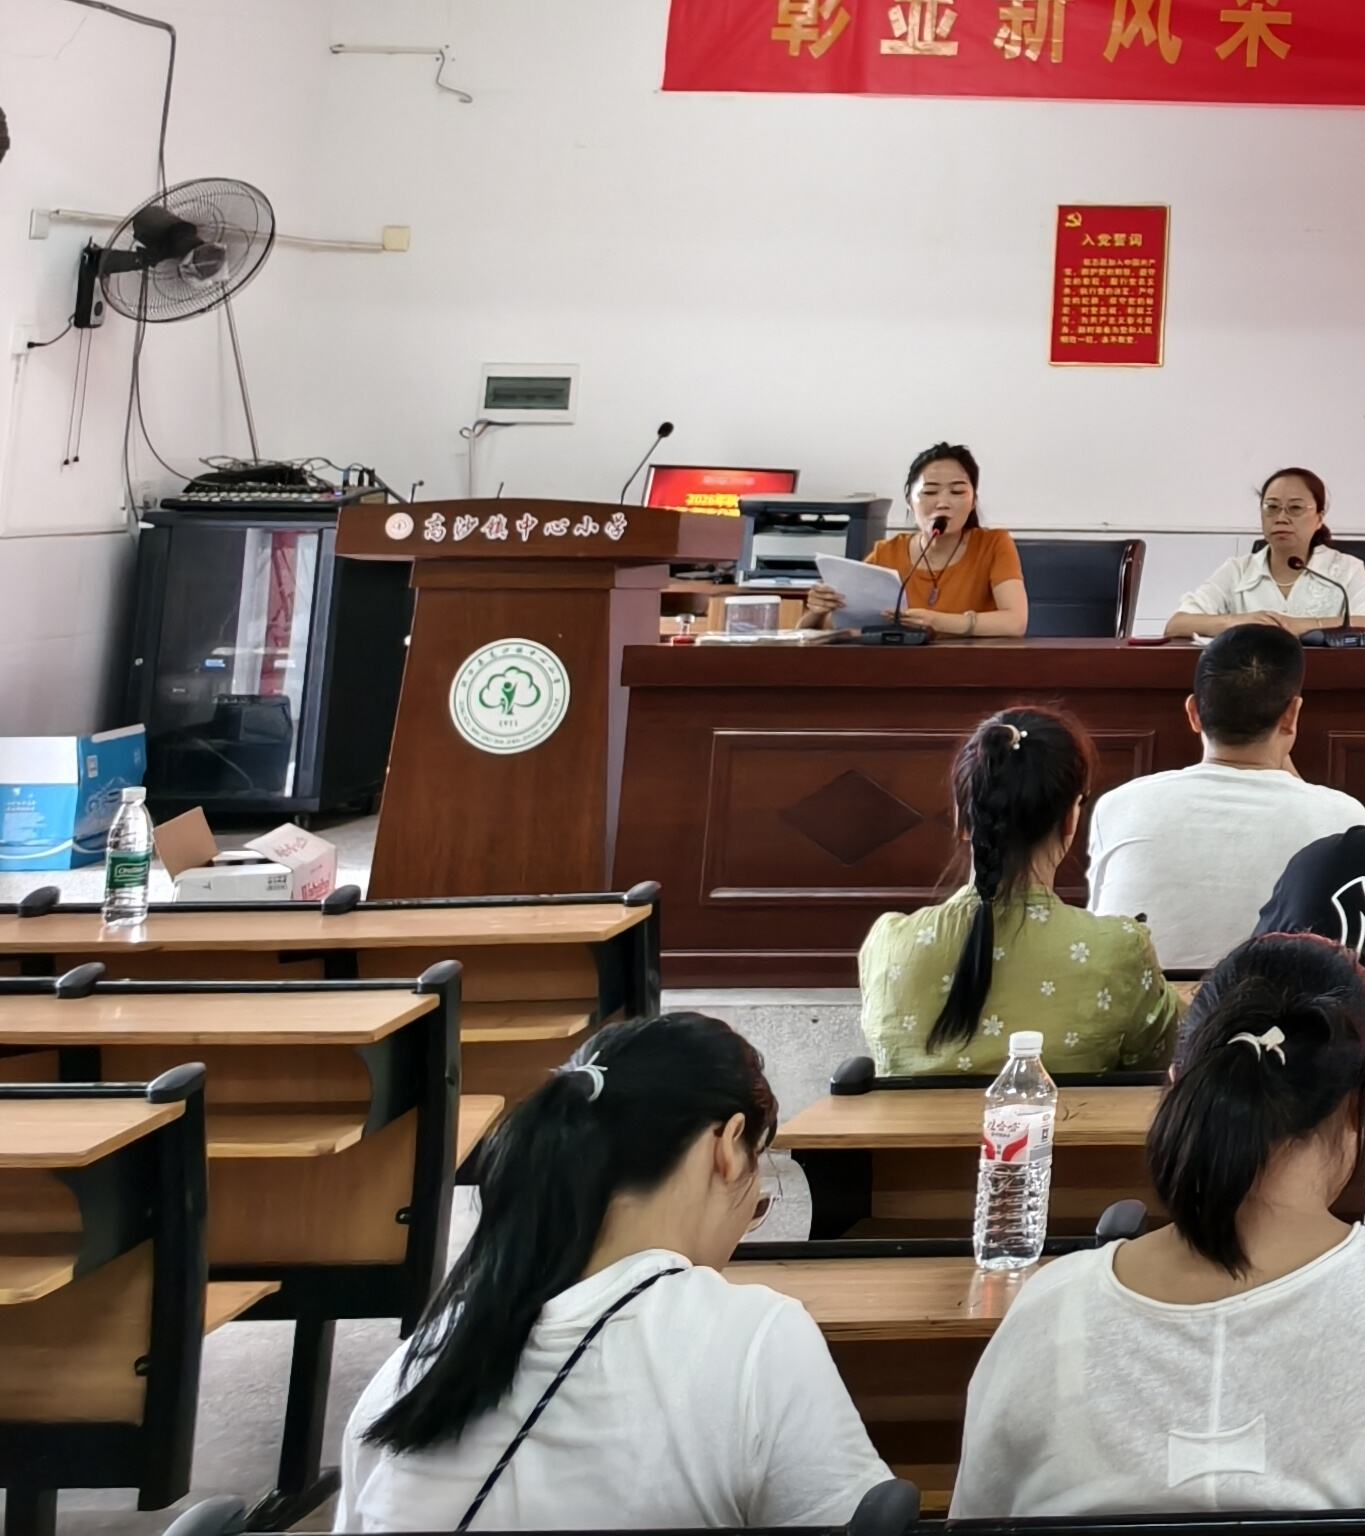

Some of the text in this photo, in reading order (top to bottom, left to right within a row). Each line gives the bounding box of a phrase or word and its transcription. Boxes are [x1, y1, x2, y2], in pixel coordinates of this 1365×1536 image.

[423, 511, 628, 542] 高沙镇中心小学
